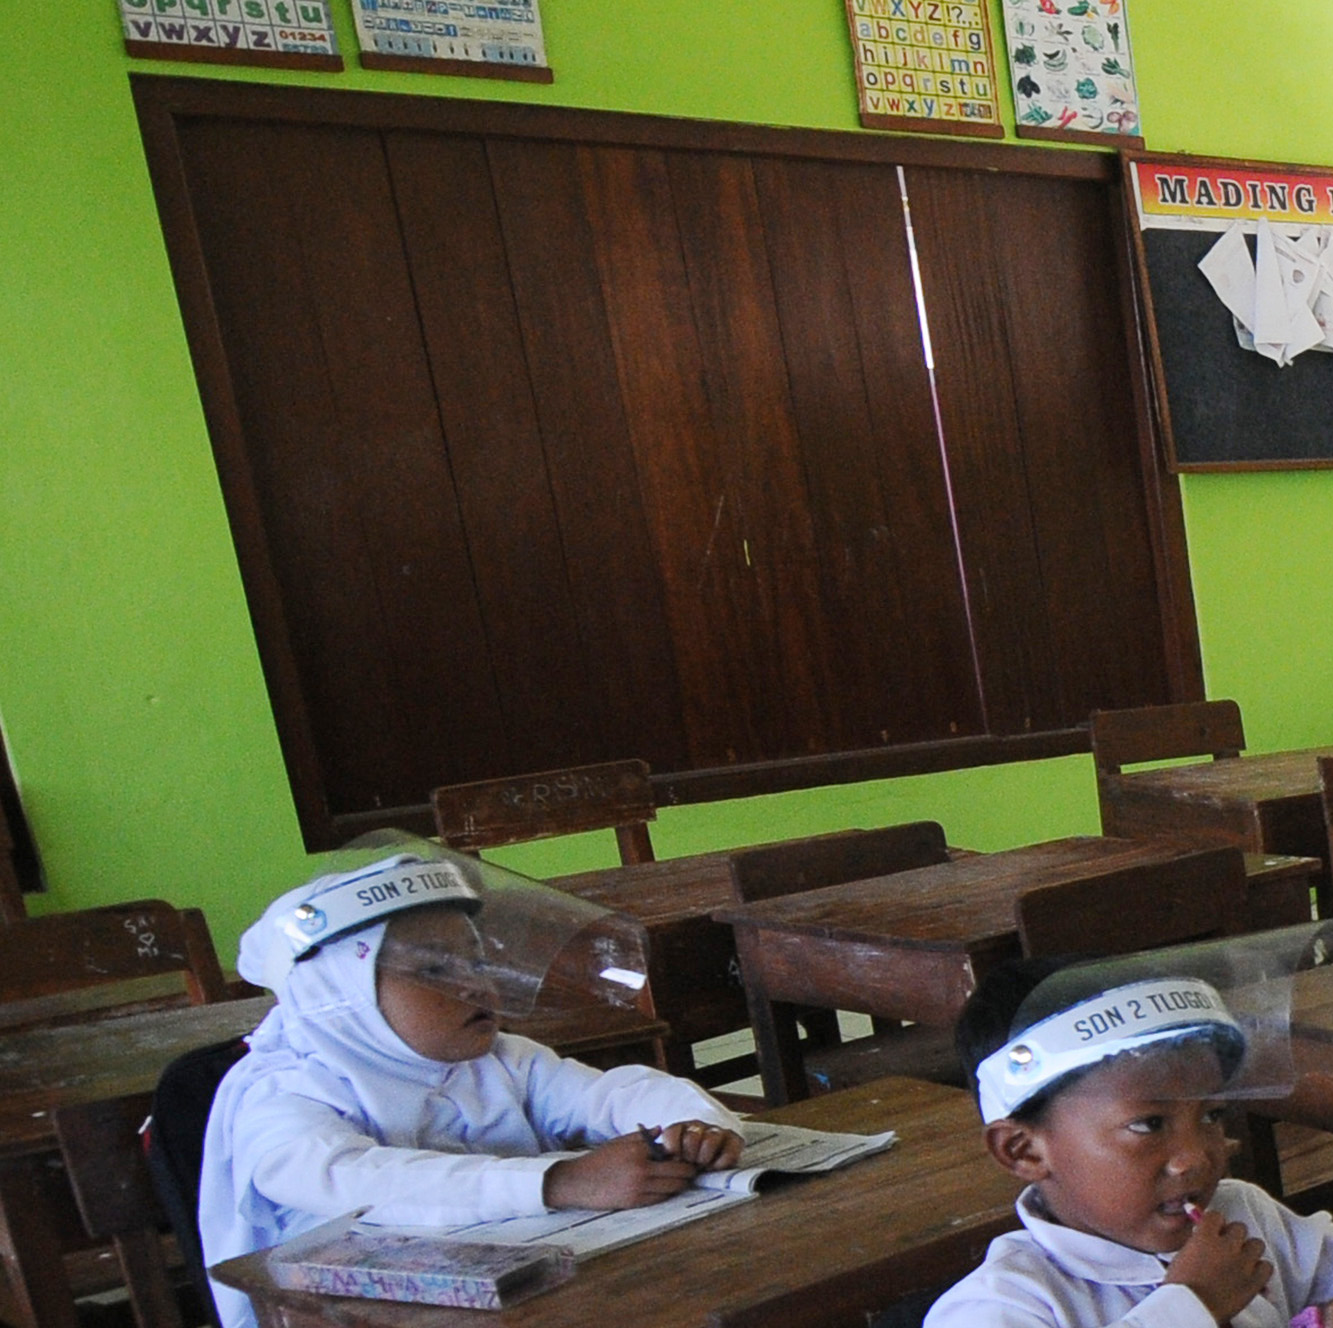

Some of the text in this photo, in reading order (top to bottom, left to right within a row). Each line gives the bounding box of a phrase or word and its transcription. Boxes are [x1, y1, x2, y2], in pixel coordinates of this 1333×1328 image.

[1155, 174, 1317, 214] MADING
[356, 881, 402, 907] SDN
[402, 877, 418, 894] 2
[1073, 1006, 1127, 1042] SDN
[1127, 999, 1148, 1020] 2
